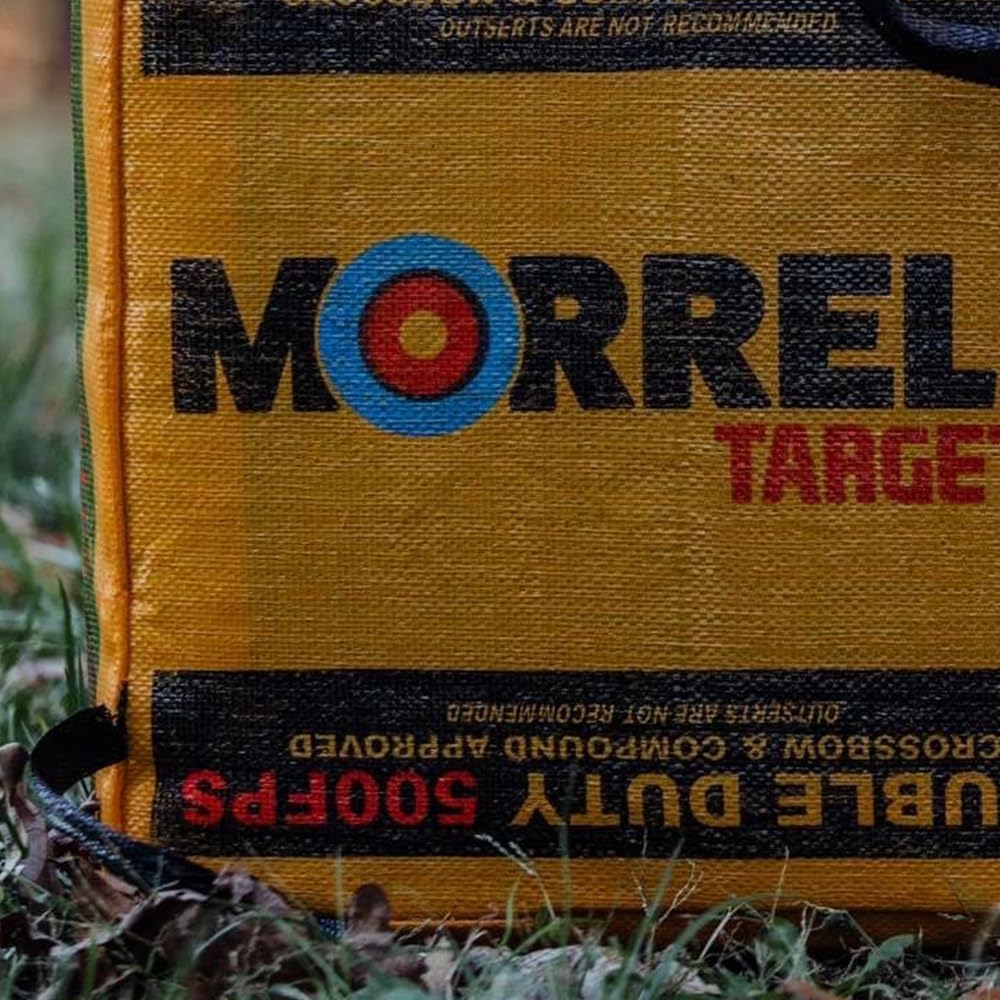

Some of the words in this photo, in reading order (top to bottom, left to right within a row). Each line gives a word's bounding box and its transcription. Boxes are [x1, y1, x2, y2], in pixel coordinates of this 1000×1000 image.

[439, 15, 554, 38] OUTSERTS
[558, 14, 601, 36] ARE
[607, 13, 655, 36] NOT
[662, 10, 840, 36] RECOMMENDED
[446, 702, 615, 724] RECOMMENDED
[621, 702, 669, 725] NOT
[672, 702, 719, 725] ARE
[726, 701, 841, 724] OUTSERTS
[289, 734, 487, 760] APPROVED
[503, 735, 727, 761] COMPOUND
[742, 736, 768, 760] &
[181, 769, 479, 827] 500FPS
[512, 771, 741, 828] DUTY
